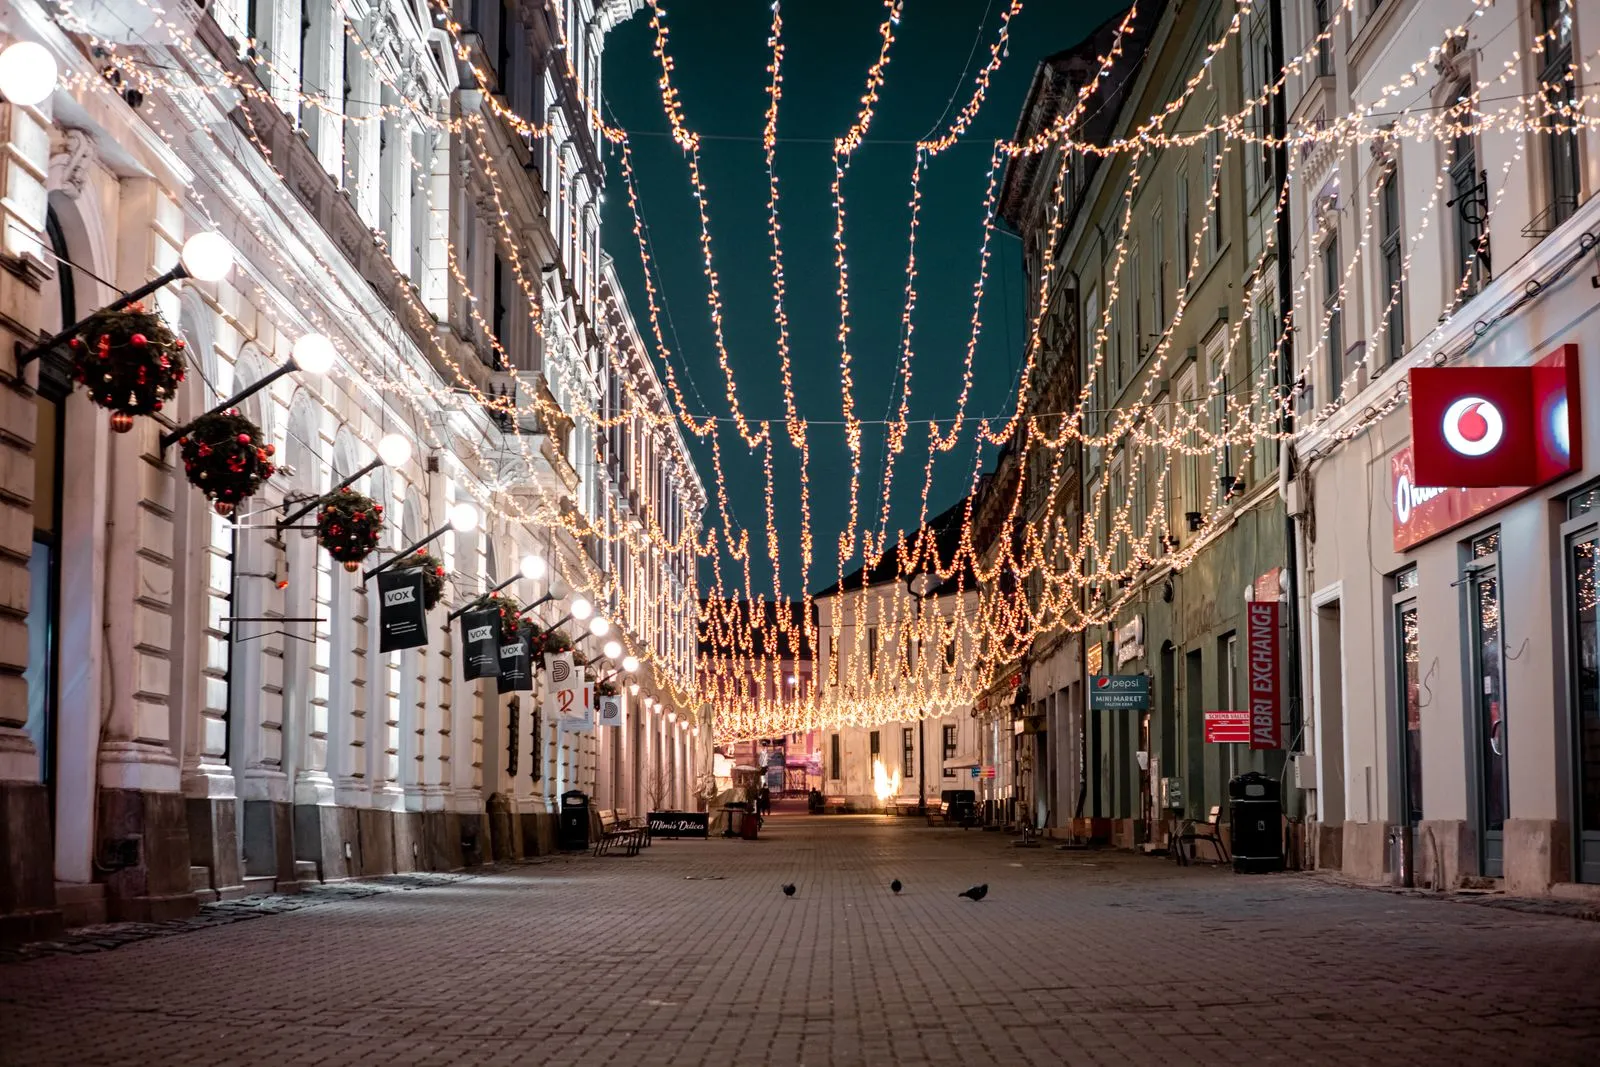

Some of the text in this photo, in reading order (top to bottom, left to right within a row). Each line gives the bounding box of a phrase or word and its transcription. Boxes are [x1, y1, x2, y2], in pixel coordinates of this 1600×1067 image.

[387, 590, 409, 602] VOX
[470, 629, 487, 639] VOX
[502, 646, 519, 655] VOX
[1251, 604, 1277, 747] JABRI EXCHANGE
[1112, 678, 1139, 689] pepsi
[650, 820, 677, 830] Mimi's
